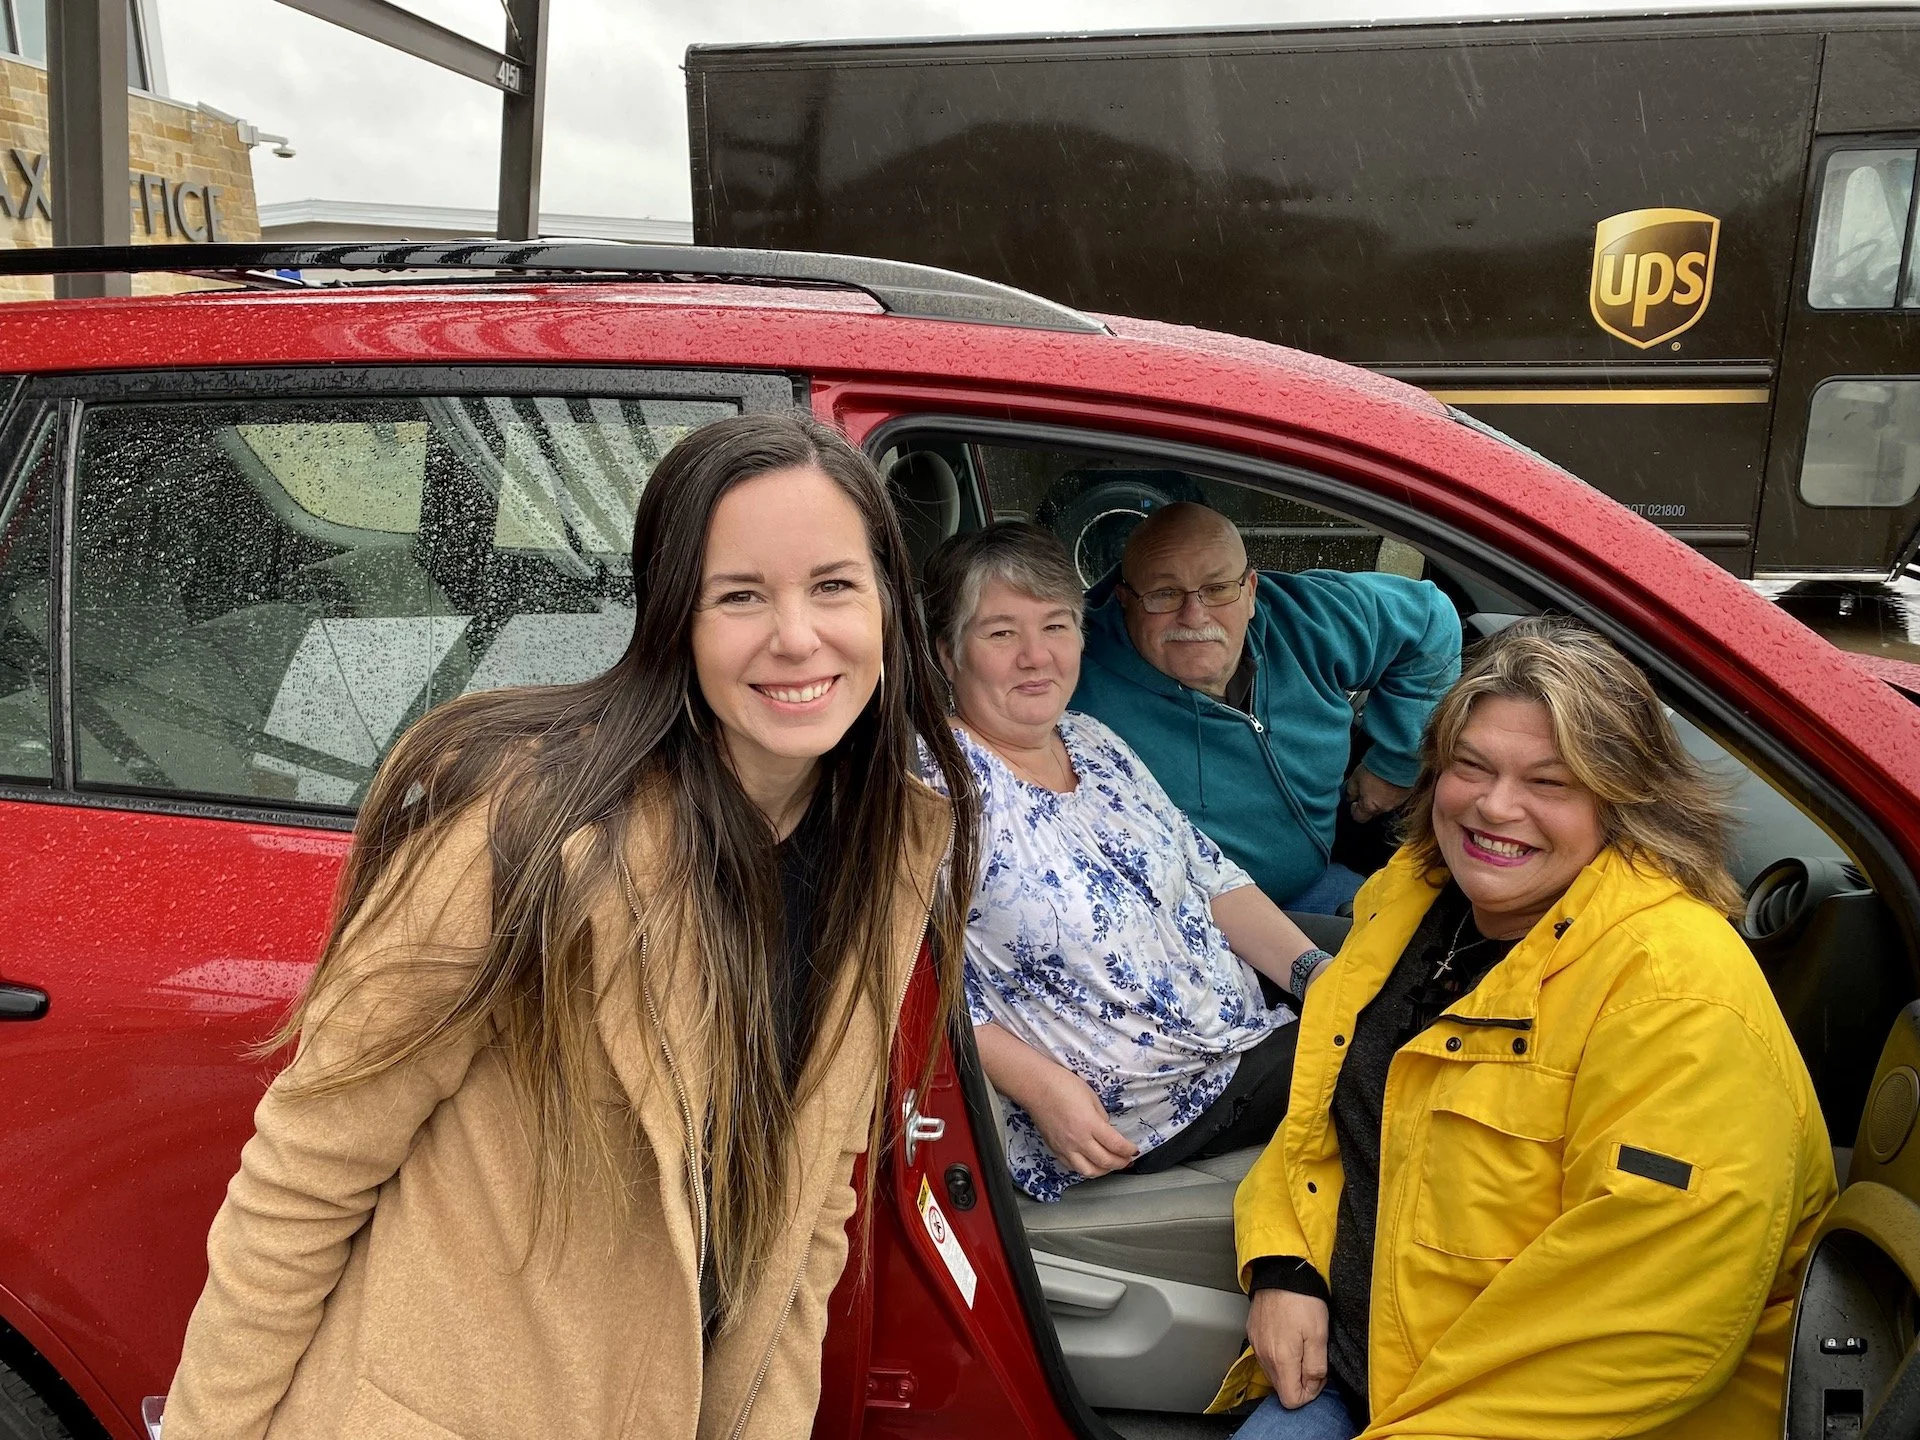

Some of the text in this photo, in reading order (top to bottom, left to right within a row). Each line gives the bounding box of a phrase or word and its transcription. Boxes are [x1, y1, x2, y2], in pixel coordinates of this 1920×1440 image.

[495, 61, 520, 90] 4151
[129, 172, 228, 242] FFICE
[1600, 251, 1706, 327] ups
[1648, 504, 1686, 517] 021800
